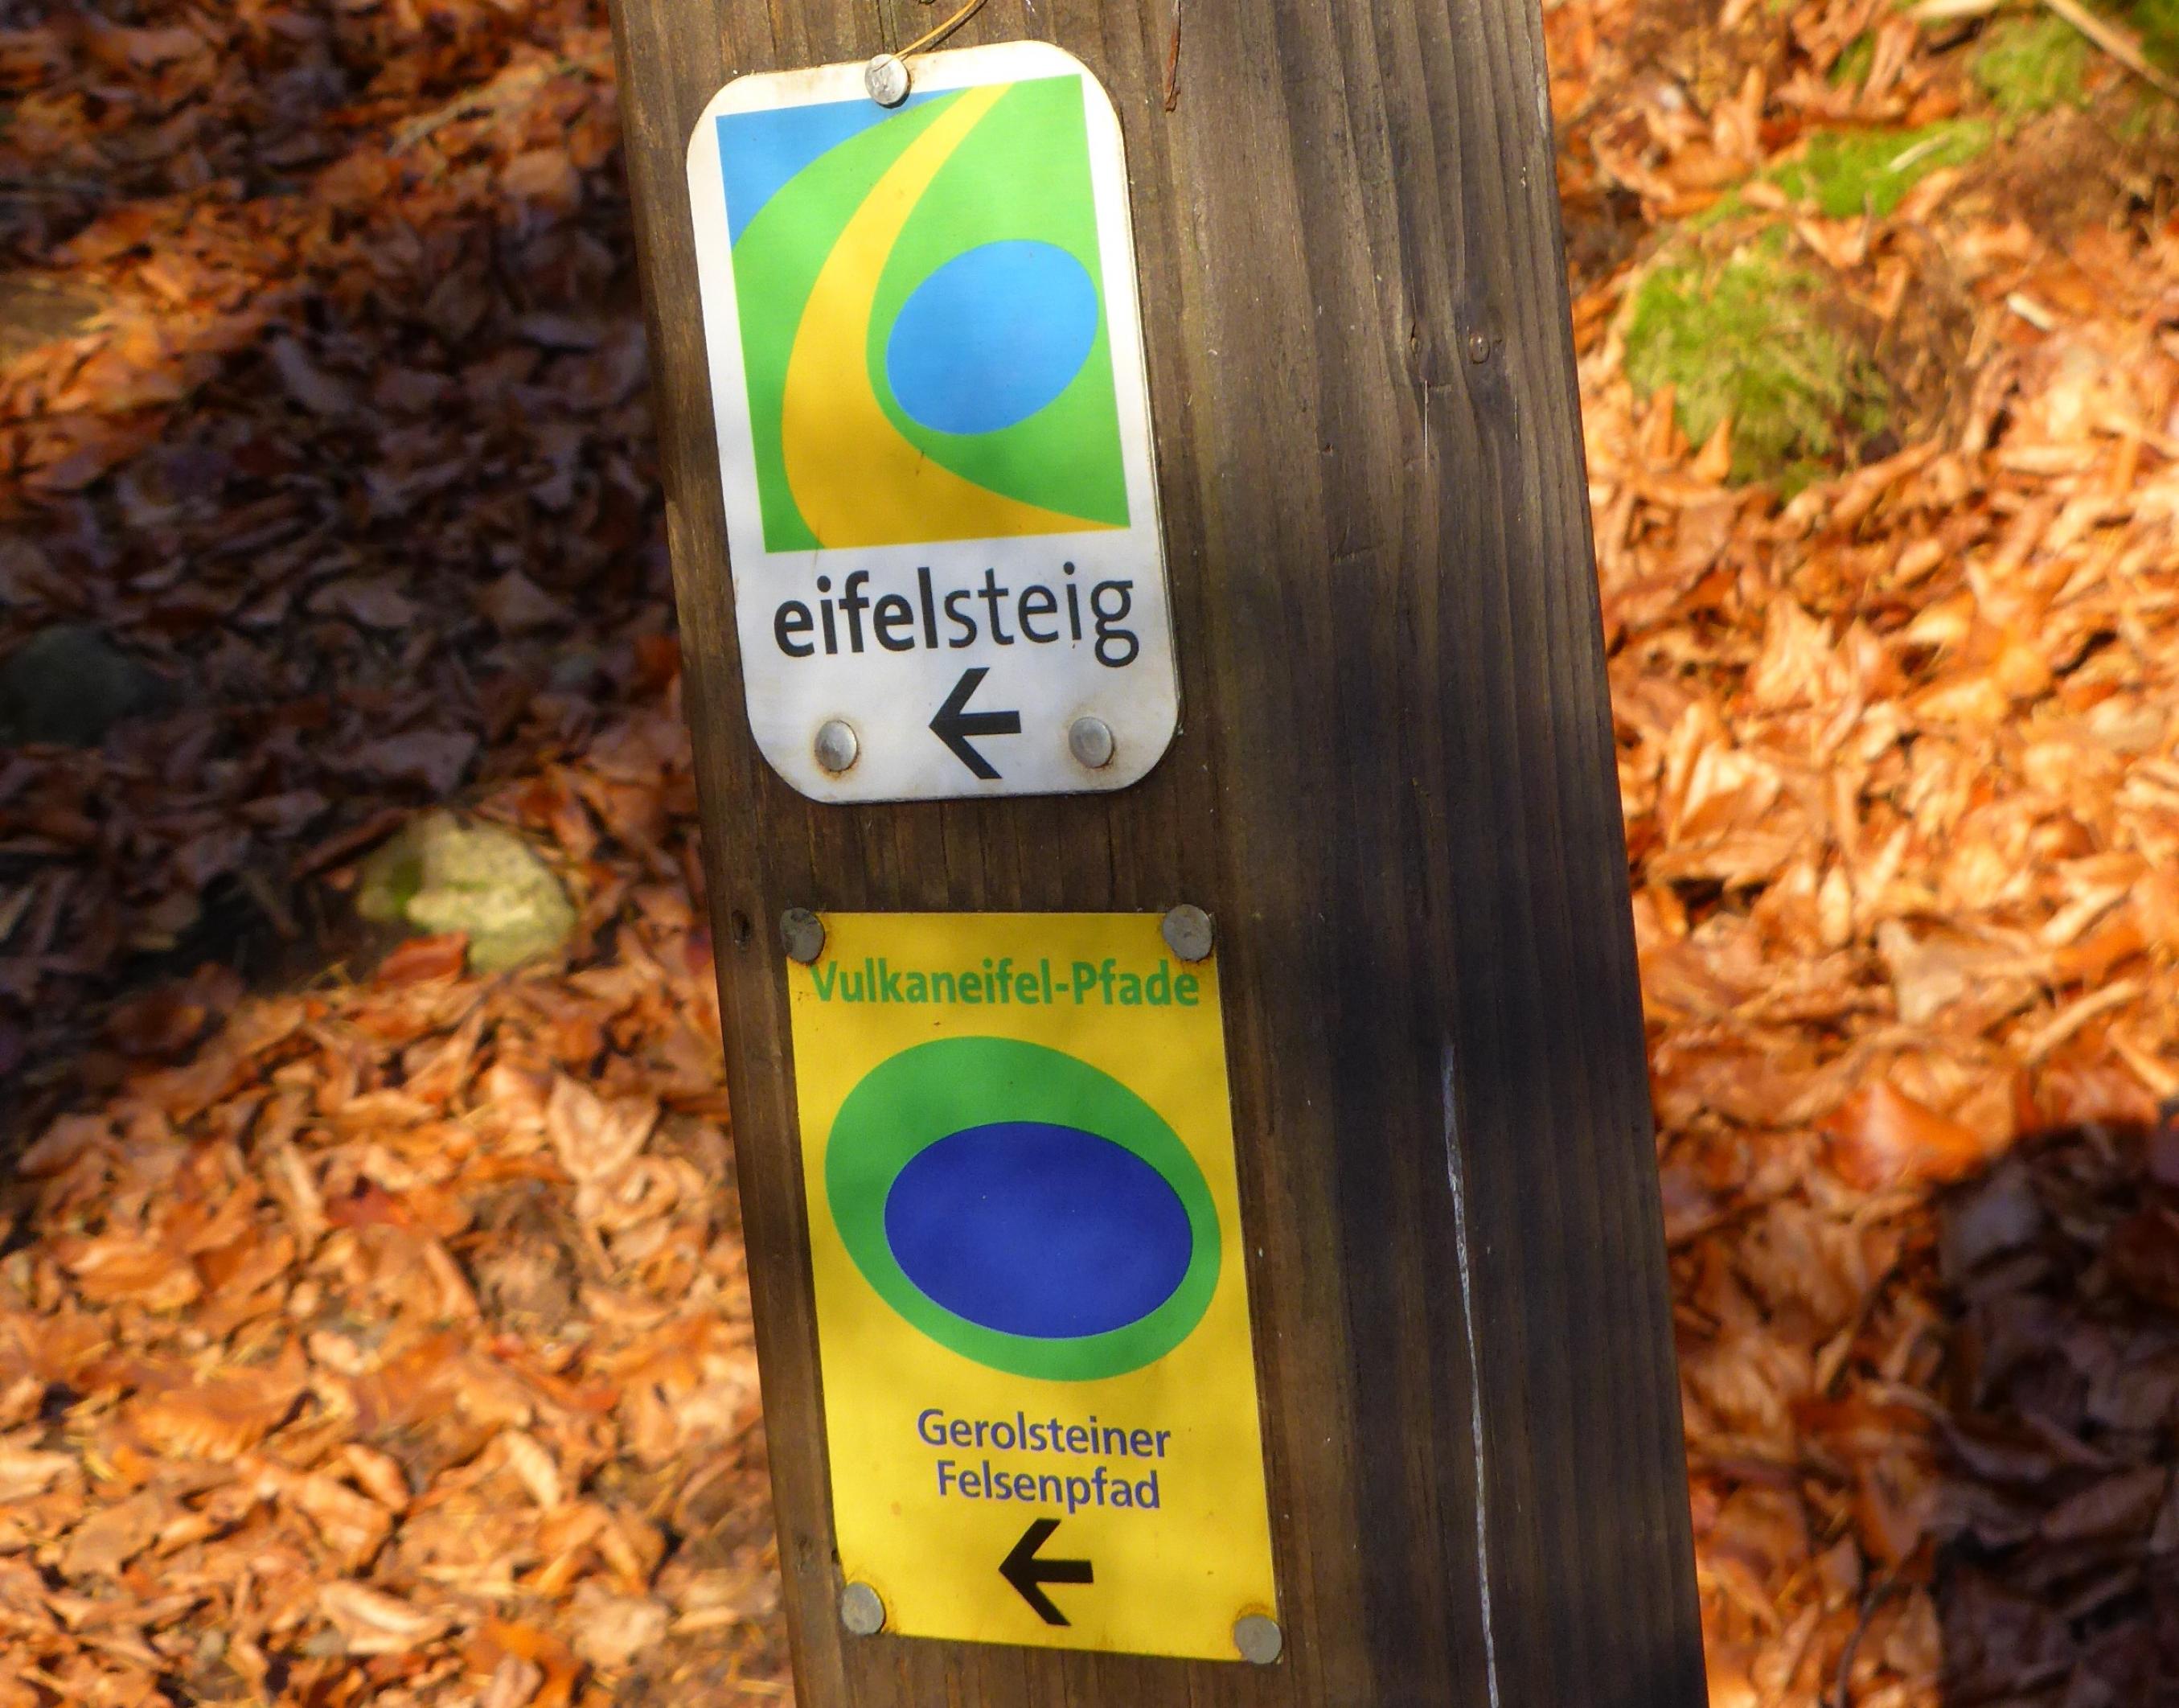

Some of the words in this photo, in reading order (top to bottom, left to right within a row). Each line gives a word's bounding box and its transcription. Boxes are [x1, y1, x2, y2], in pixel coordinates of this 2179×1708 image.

[774, 561, 1139, 668] eifelsteig
[810, 957, 1200, 1007] Vulkaneifel-Pfade
[917, 1408, 1172, 1458] Gerolsteiner
[938, 1460, 1160, 1515] Felsenpfad
